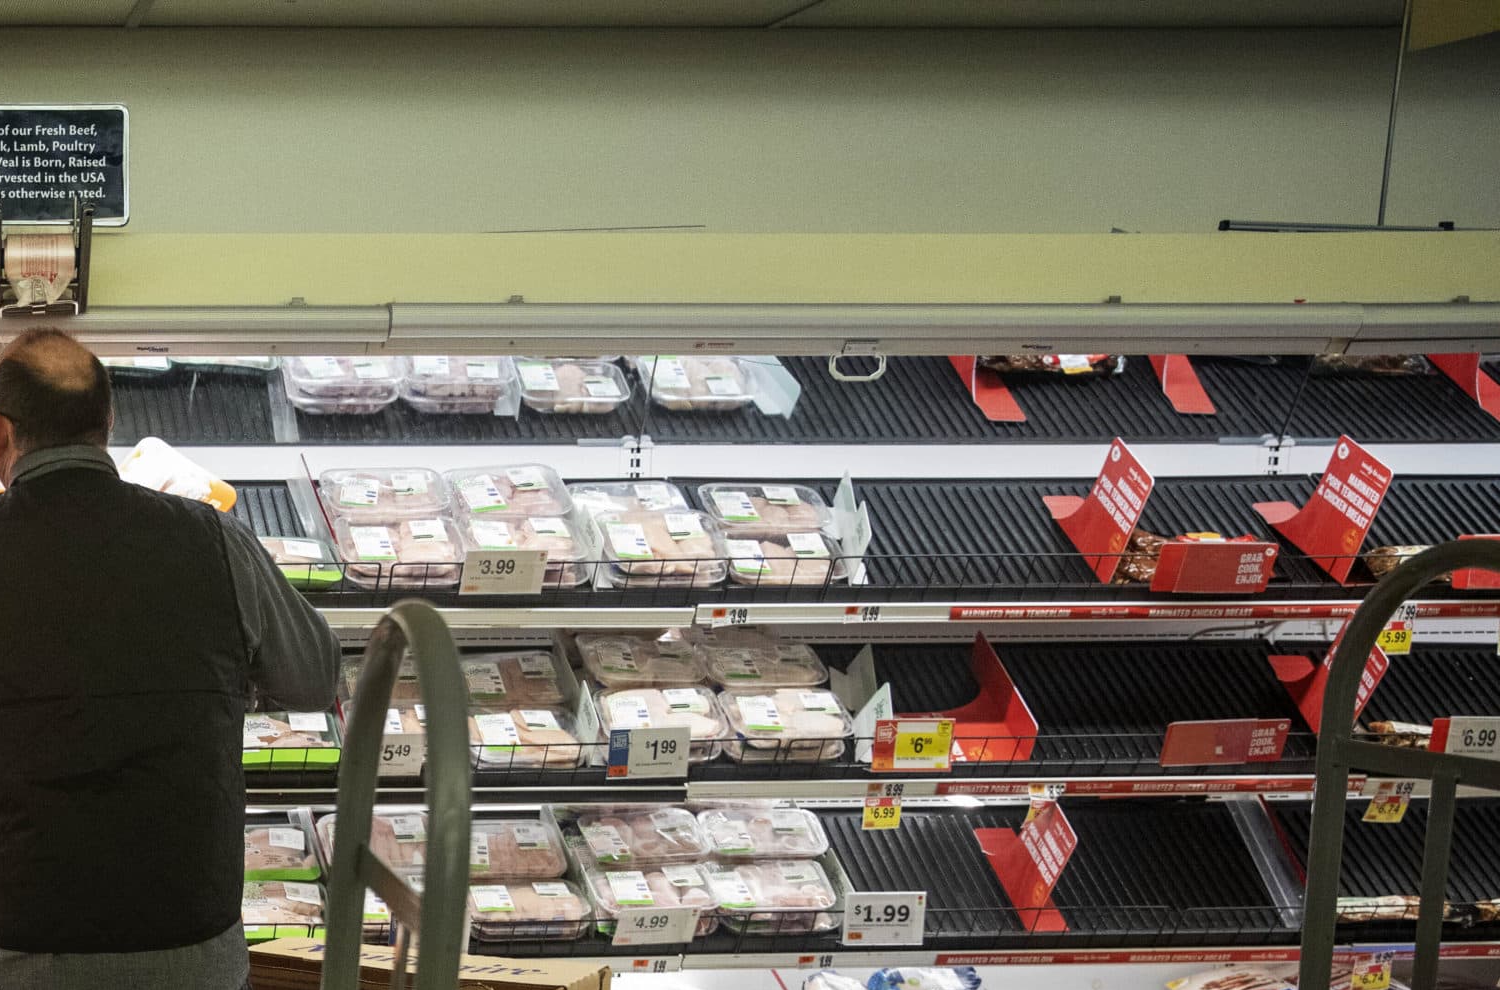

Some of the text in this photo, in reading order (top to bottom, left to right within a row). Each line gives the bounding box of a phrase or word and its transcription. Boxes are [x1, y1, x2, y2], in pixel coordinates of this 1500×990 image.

[12, 128, 32, 136] our
[35, 125, 65, 136] Fresh
[69, 124, 97, 138] Beef,
[14, 141, 49, 153] Lamb,
[52, 141, 95, 154] Poultry
[22, 157, 30, 167] is
[34, 157, 65, 168] Born,
[69, 156, 106, 167] Raised
[44, 172, 55, 183] in
[59, 172, 77, 183] the
[81, 172, 106, 183] USA
[8, 188, 66, 198] otherwise
[1347, 473, 1381, 504] MARINATED
[1326, 473, 1342, 491] PORK
[1341, 484, 1375, 517] TENDERLOIN
[1323, 488, 1347, 513] CHICKEN
[1346, 506, 1369, 529] BREAST
[1240, 553, 1263, 563] GRAB.
[1238, 564, 1261, 573] COOK.
[1236, 574, 1263, 584] ENJOY.
[961, 608, 1071, 618] MARINATED PORK TENDERLOIN
[1148, 608, 1253, 617] MARINATED CHICKEN BREAST
[854, 905, 910, 922] $1.99
[634, 915, 668, 929] $4.99
[947, 955, 1054, 965] MARINATED PORK TENDERLOIN
[1129, 954, 1170, 963] MARINATED
[1204, 953, 1232, 961] BREAST
